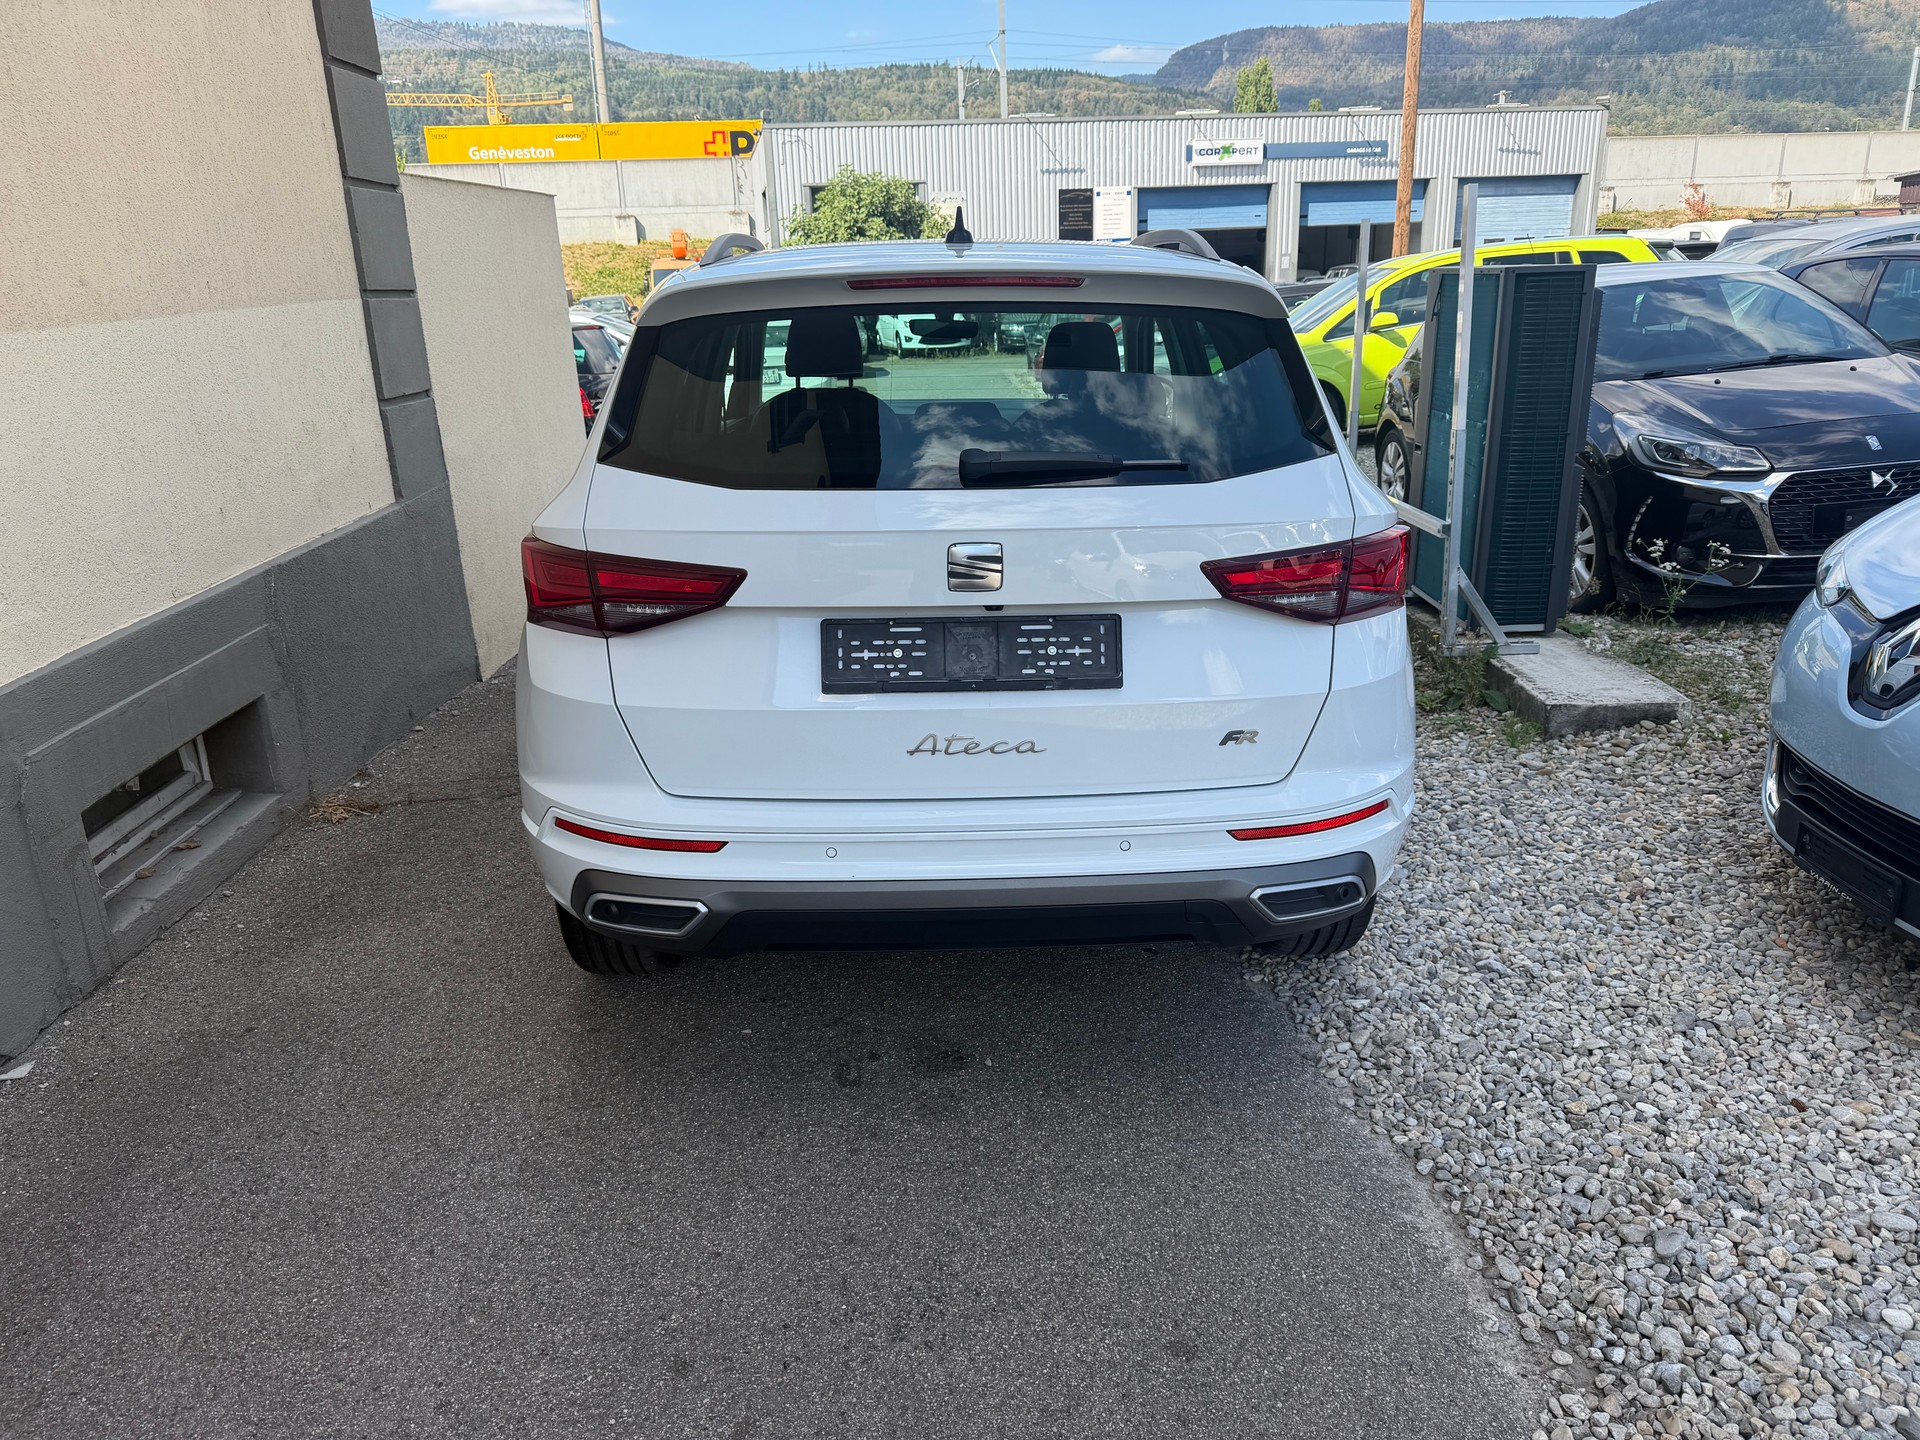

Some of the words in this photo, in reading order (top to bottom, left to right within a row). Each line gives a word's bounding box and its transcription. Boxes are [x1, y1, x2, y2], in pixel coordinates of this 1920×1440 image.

[468, 146, 555, 160] Genèveston
[906, 732, 1047, 756] Ateca
[1218, 729, 1260, 747] FR
